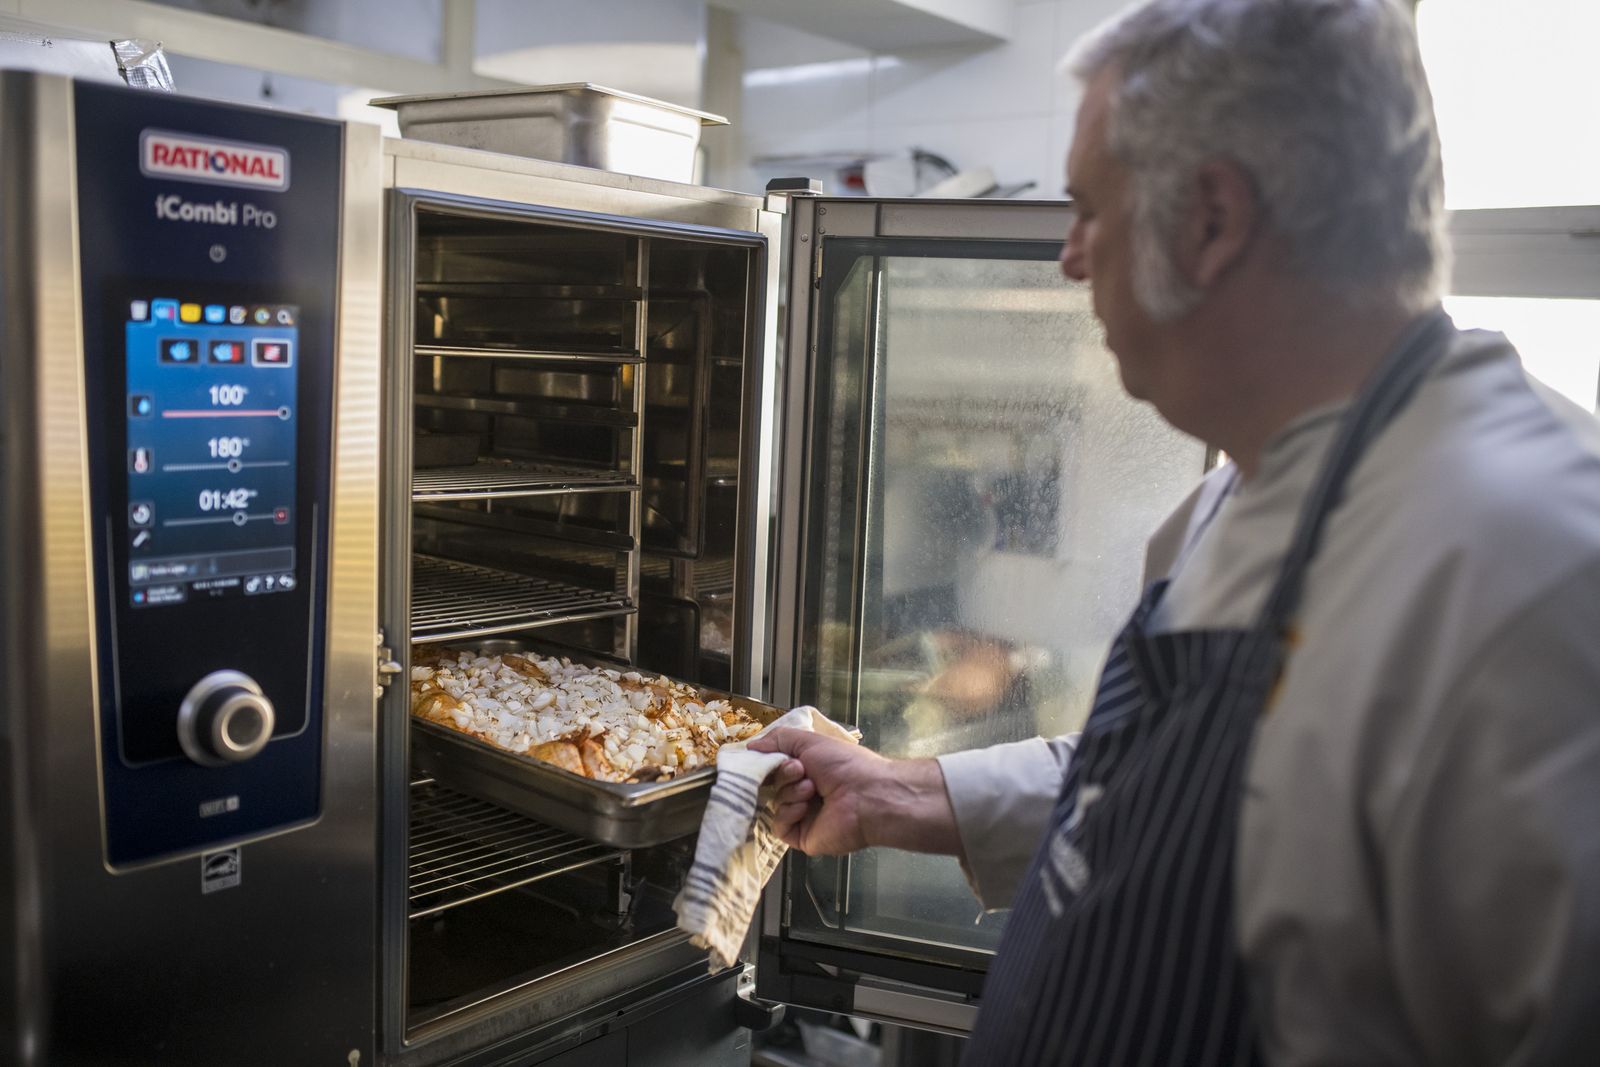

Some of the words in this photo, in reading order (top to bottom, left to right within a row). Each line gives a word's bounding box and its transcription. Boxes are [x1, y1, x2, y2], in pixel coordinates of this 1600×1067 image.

[152, 143, 280, 179] RATIONAL
[156, 194, 237, 225] iCombi
[243, 204, 277, 228] Pro
